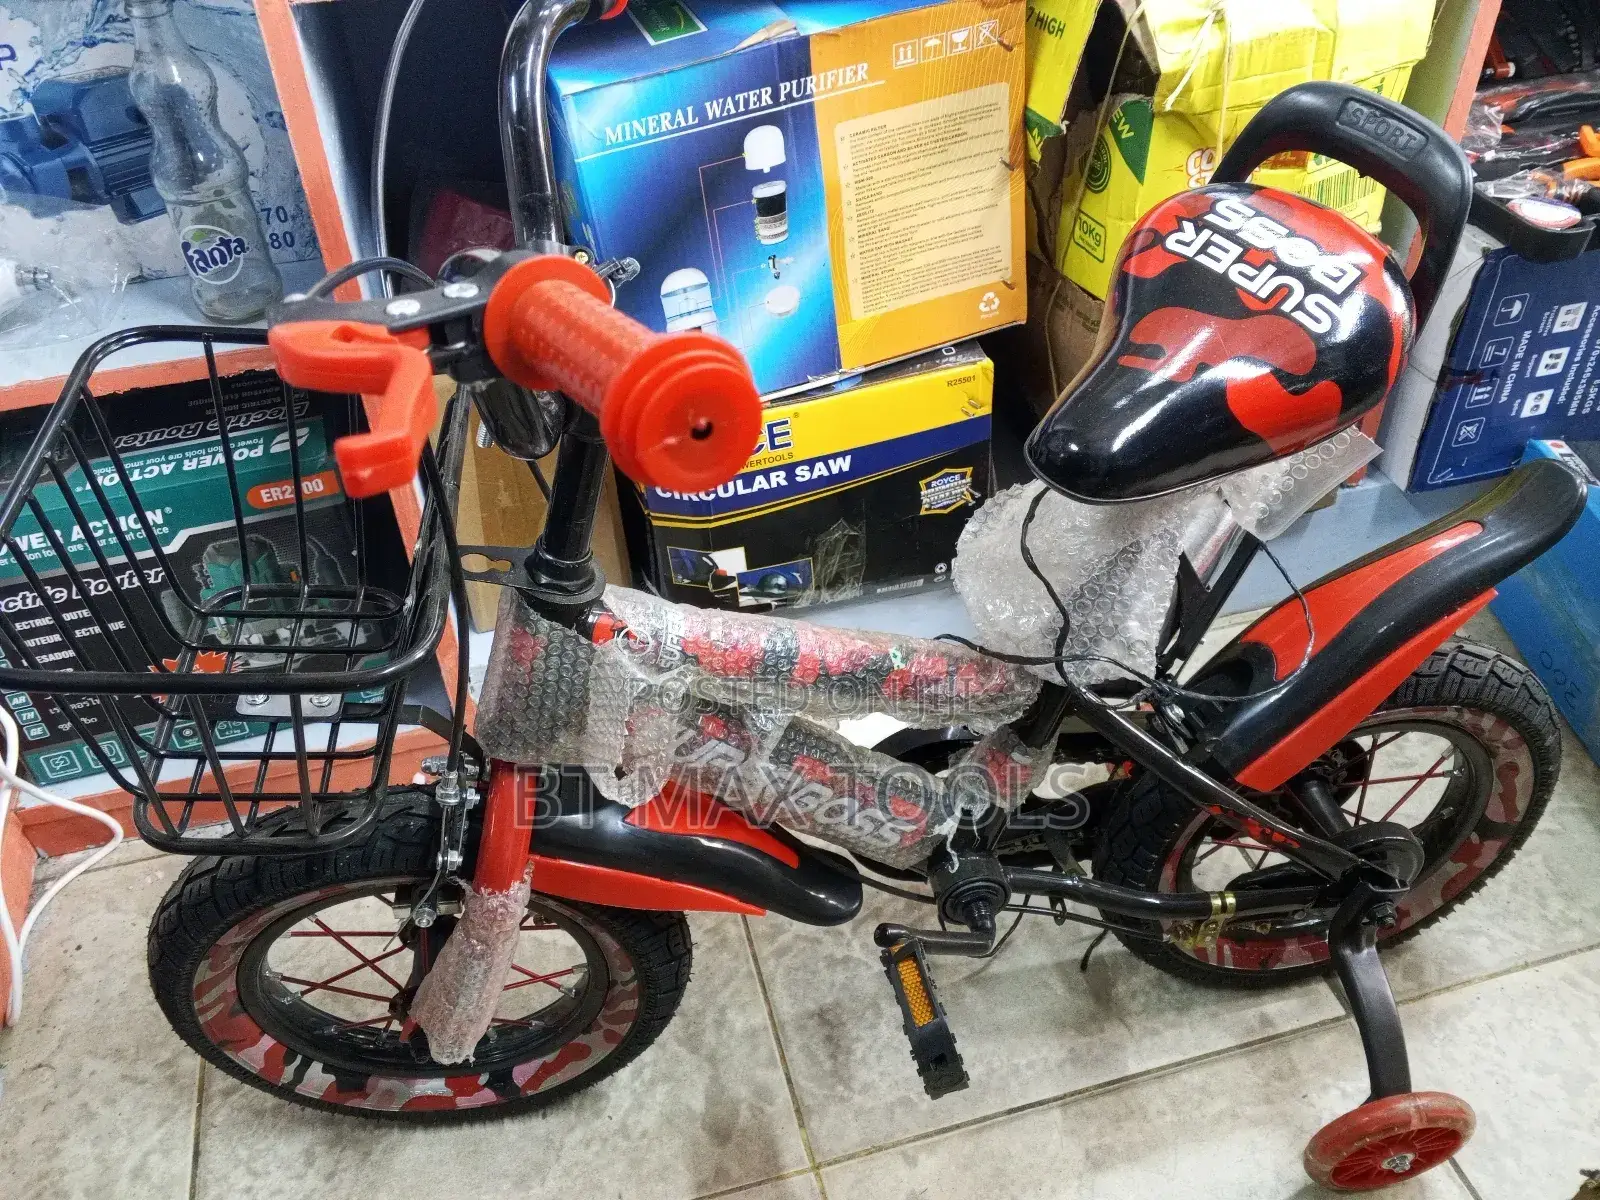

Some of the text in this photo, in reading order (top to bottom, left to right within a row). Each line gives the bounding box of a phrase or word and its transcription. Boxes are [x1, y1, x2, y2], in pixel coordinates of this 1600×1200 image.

[1035, 10, 1067, 40] HIGH
[604, 62, 869, 147] MINERAL WATER PURIFIER
[1352, 107, 1417, 152] SPORT
[261, 205, 289, 225] 70
[268, 230, 296, 250] 80
[1077, 215, 1103, 247] 10Kg
[181, 236, 250, 278] Fanta
[1203, 198, 1363, 296] BOSS
[1164, 219, 1333, 334] SUPER
[1498, 329, 1533, 404] MADE IN CHINA
[946, 374, 977, 388] R25501
[236, 437, 264, 447] Power
[145, 455, 166, 466] your
[167, 452, 183, 462] are
[185, 447, 206, 458] tools
[85, 444, 265, 492] POWER ACTON
[795, 455, 852, 483] SAW
[930, 473, 962, 488] ROYCE
[259, 478, 325, 504] ER200
[67, 543, 85, 553] are
[11, 696, 27, 706] AR
[20, 711, 35, 721] TH
[29, 726, 44, 737] GE
